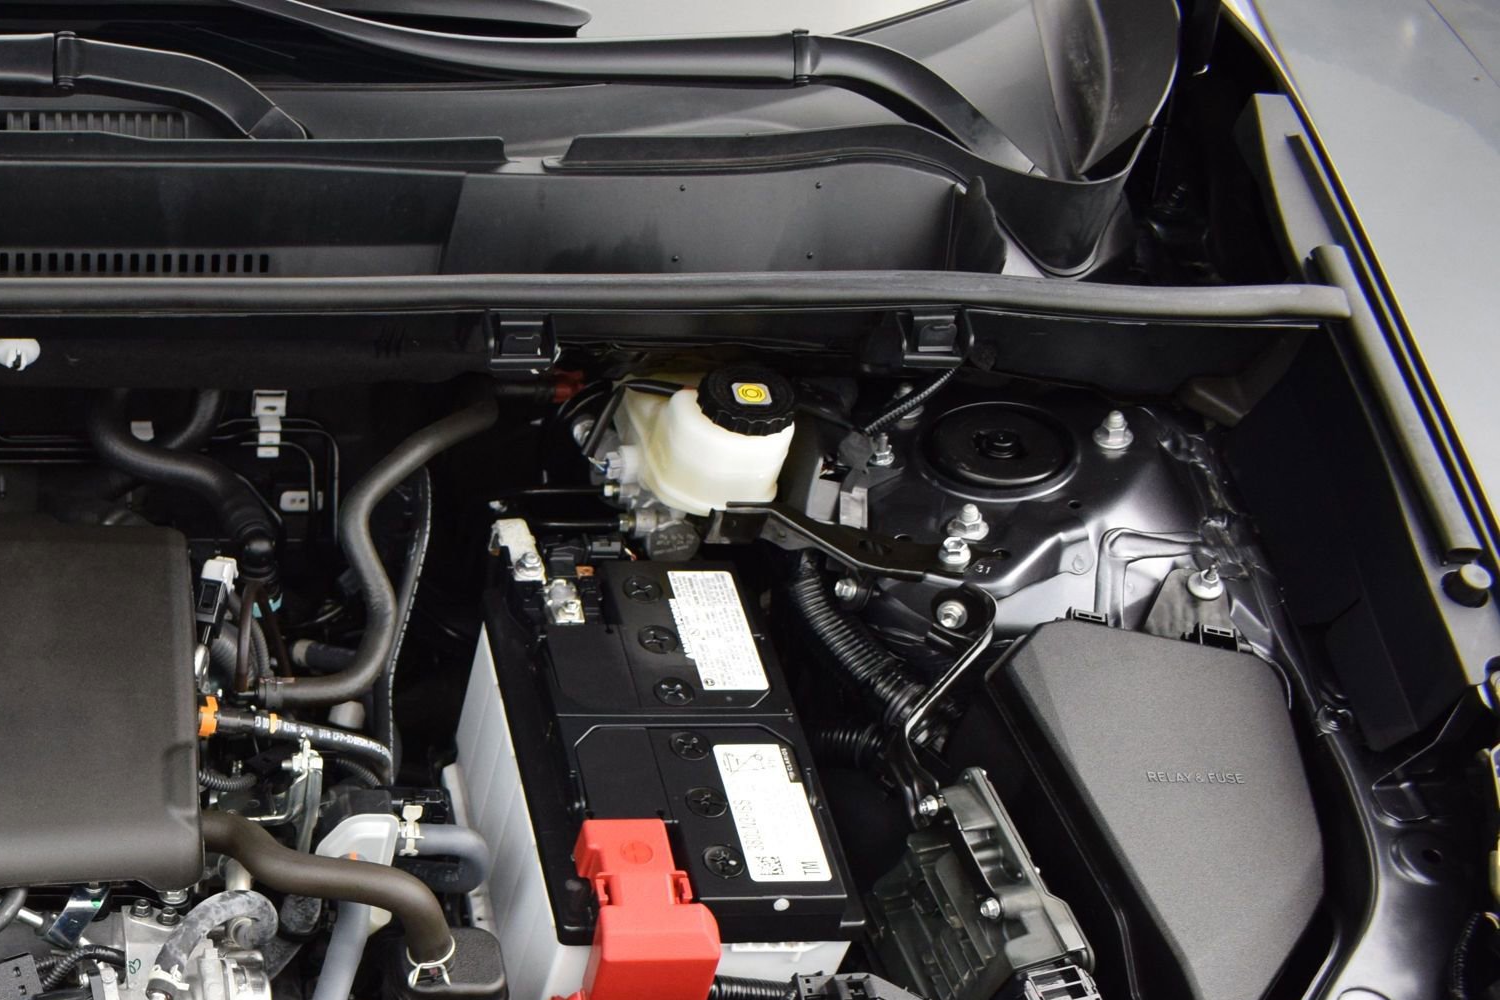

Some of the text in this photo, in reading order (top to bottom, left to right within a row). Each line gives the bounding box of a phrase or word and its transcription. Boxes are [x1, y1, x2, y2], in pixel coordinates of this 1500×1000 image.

[781, 748, 793, 772] CLARIOS
[1146, 771, 1245, 784] RELAY & FUSE
[801, 861, 821, 875] TM
